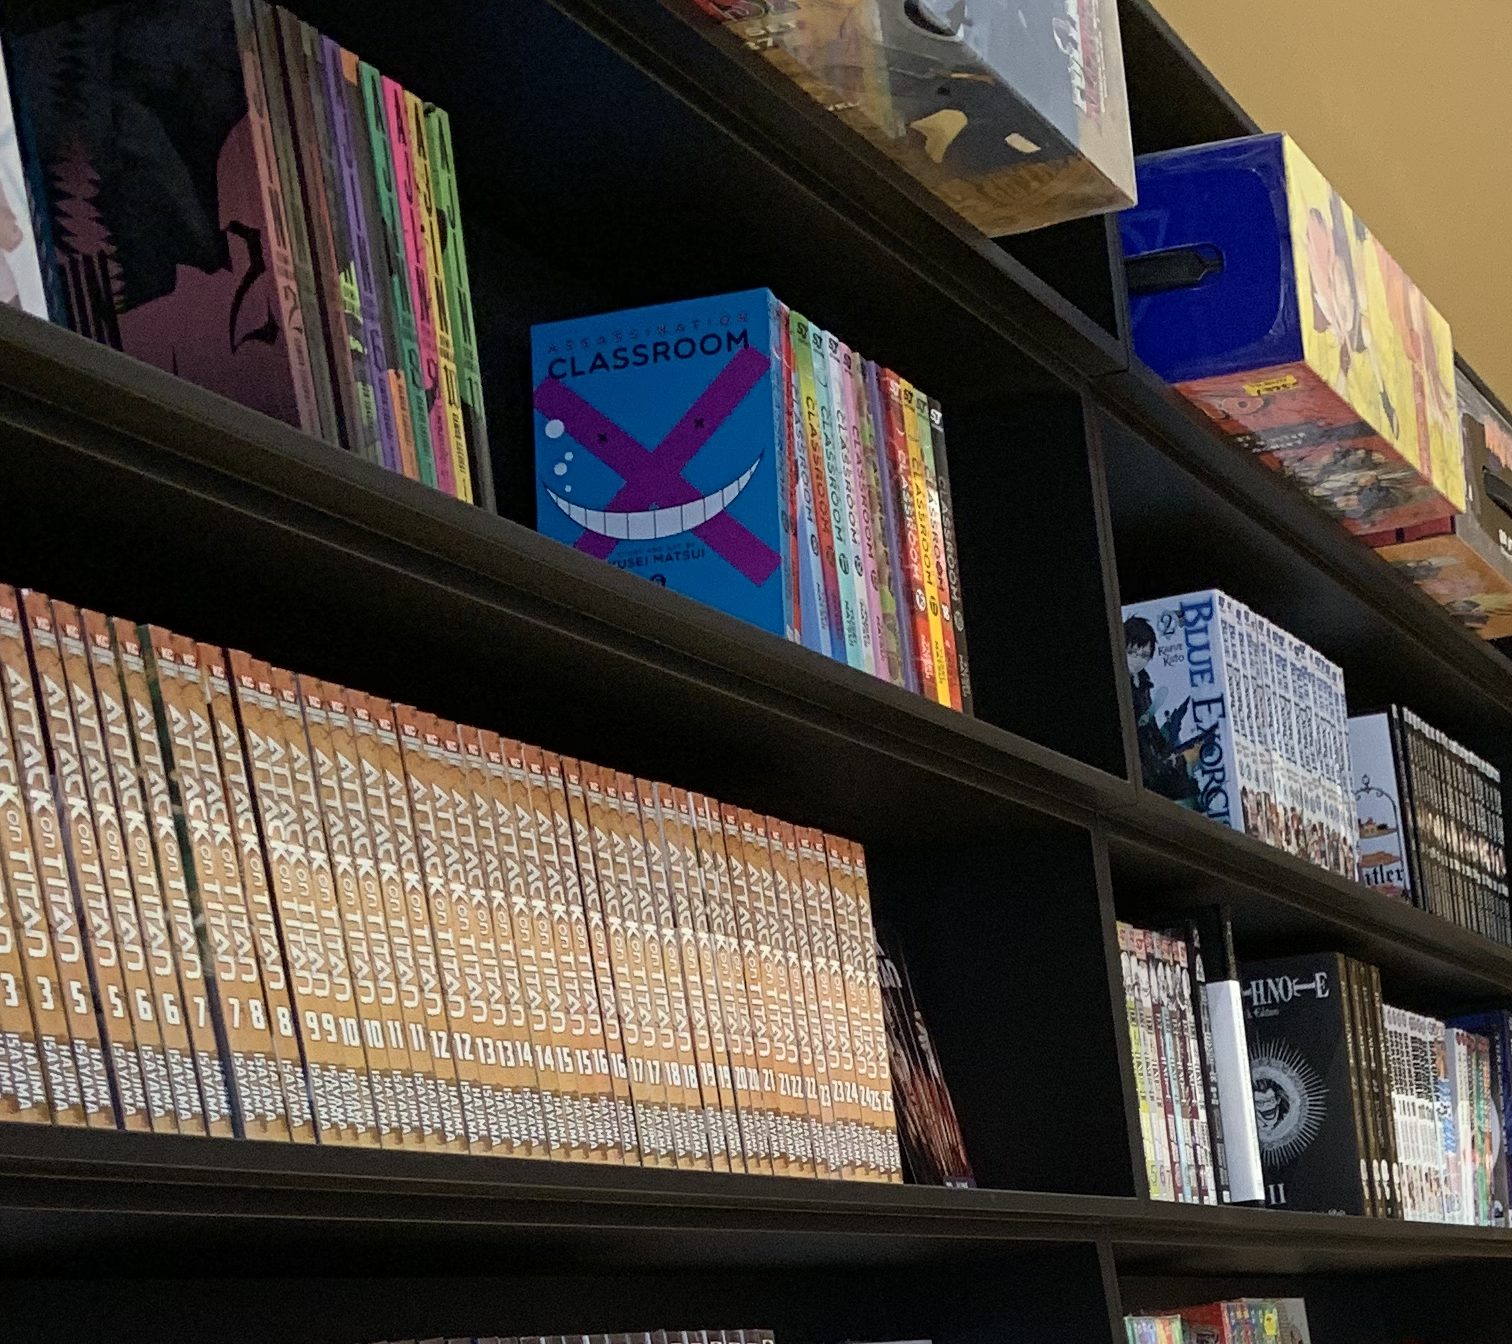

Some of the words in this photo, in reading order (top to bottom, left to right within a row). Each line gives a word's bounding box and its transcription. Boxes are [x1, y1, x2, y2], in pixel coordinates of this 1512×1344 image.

[547, 329, 750, 380] CLASSROOM
[806, 395, 833, 546] CLASSROOM
[820, 405, 845, 543] CLASSROOM
[652, 549, 705, 566] MATSUI
[1159, 613, 1176, 636] 2
[1181, 596, 1215, 689] BLUE
[6, 664, 53, 814] ATTACK
[43, 673, 91, 823] ATTACK
[40, 817, 56, 848] on
[78, 823, 92, 855] on
[43, 853, 82, 964] TITAN
[81, 860, 117, 968] TITAN
[69, 980, 88, 1015] 5
[107, 985, 124, 1018] 5
[194, 997, 206, 1028] 7
[74, 1039, 99, 1114] ISAYAMA
[90, 1048, 110, 1108] HAJIME
